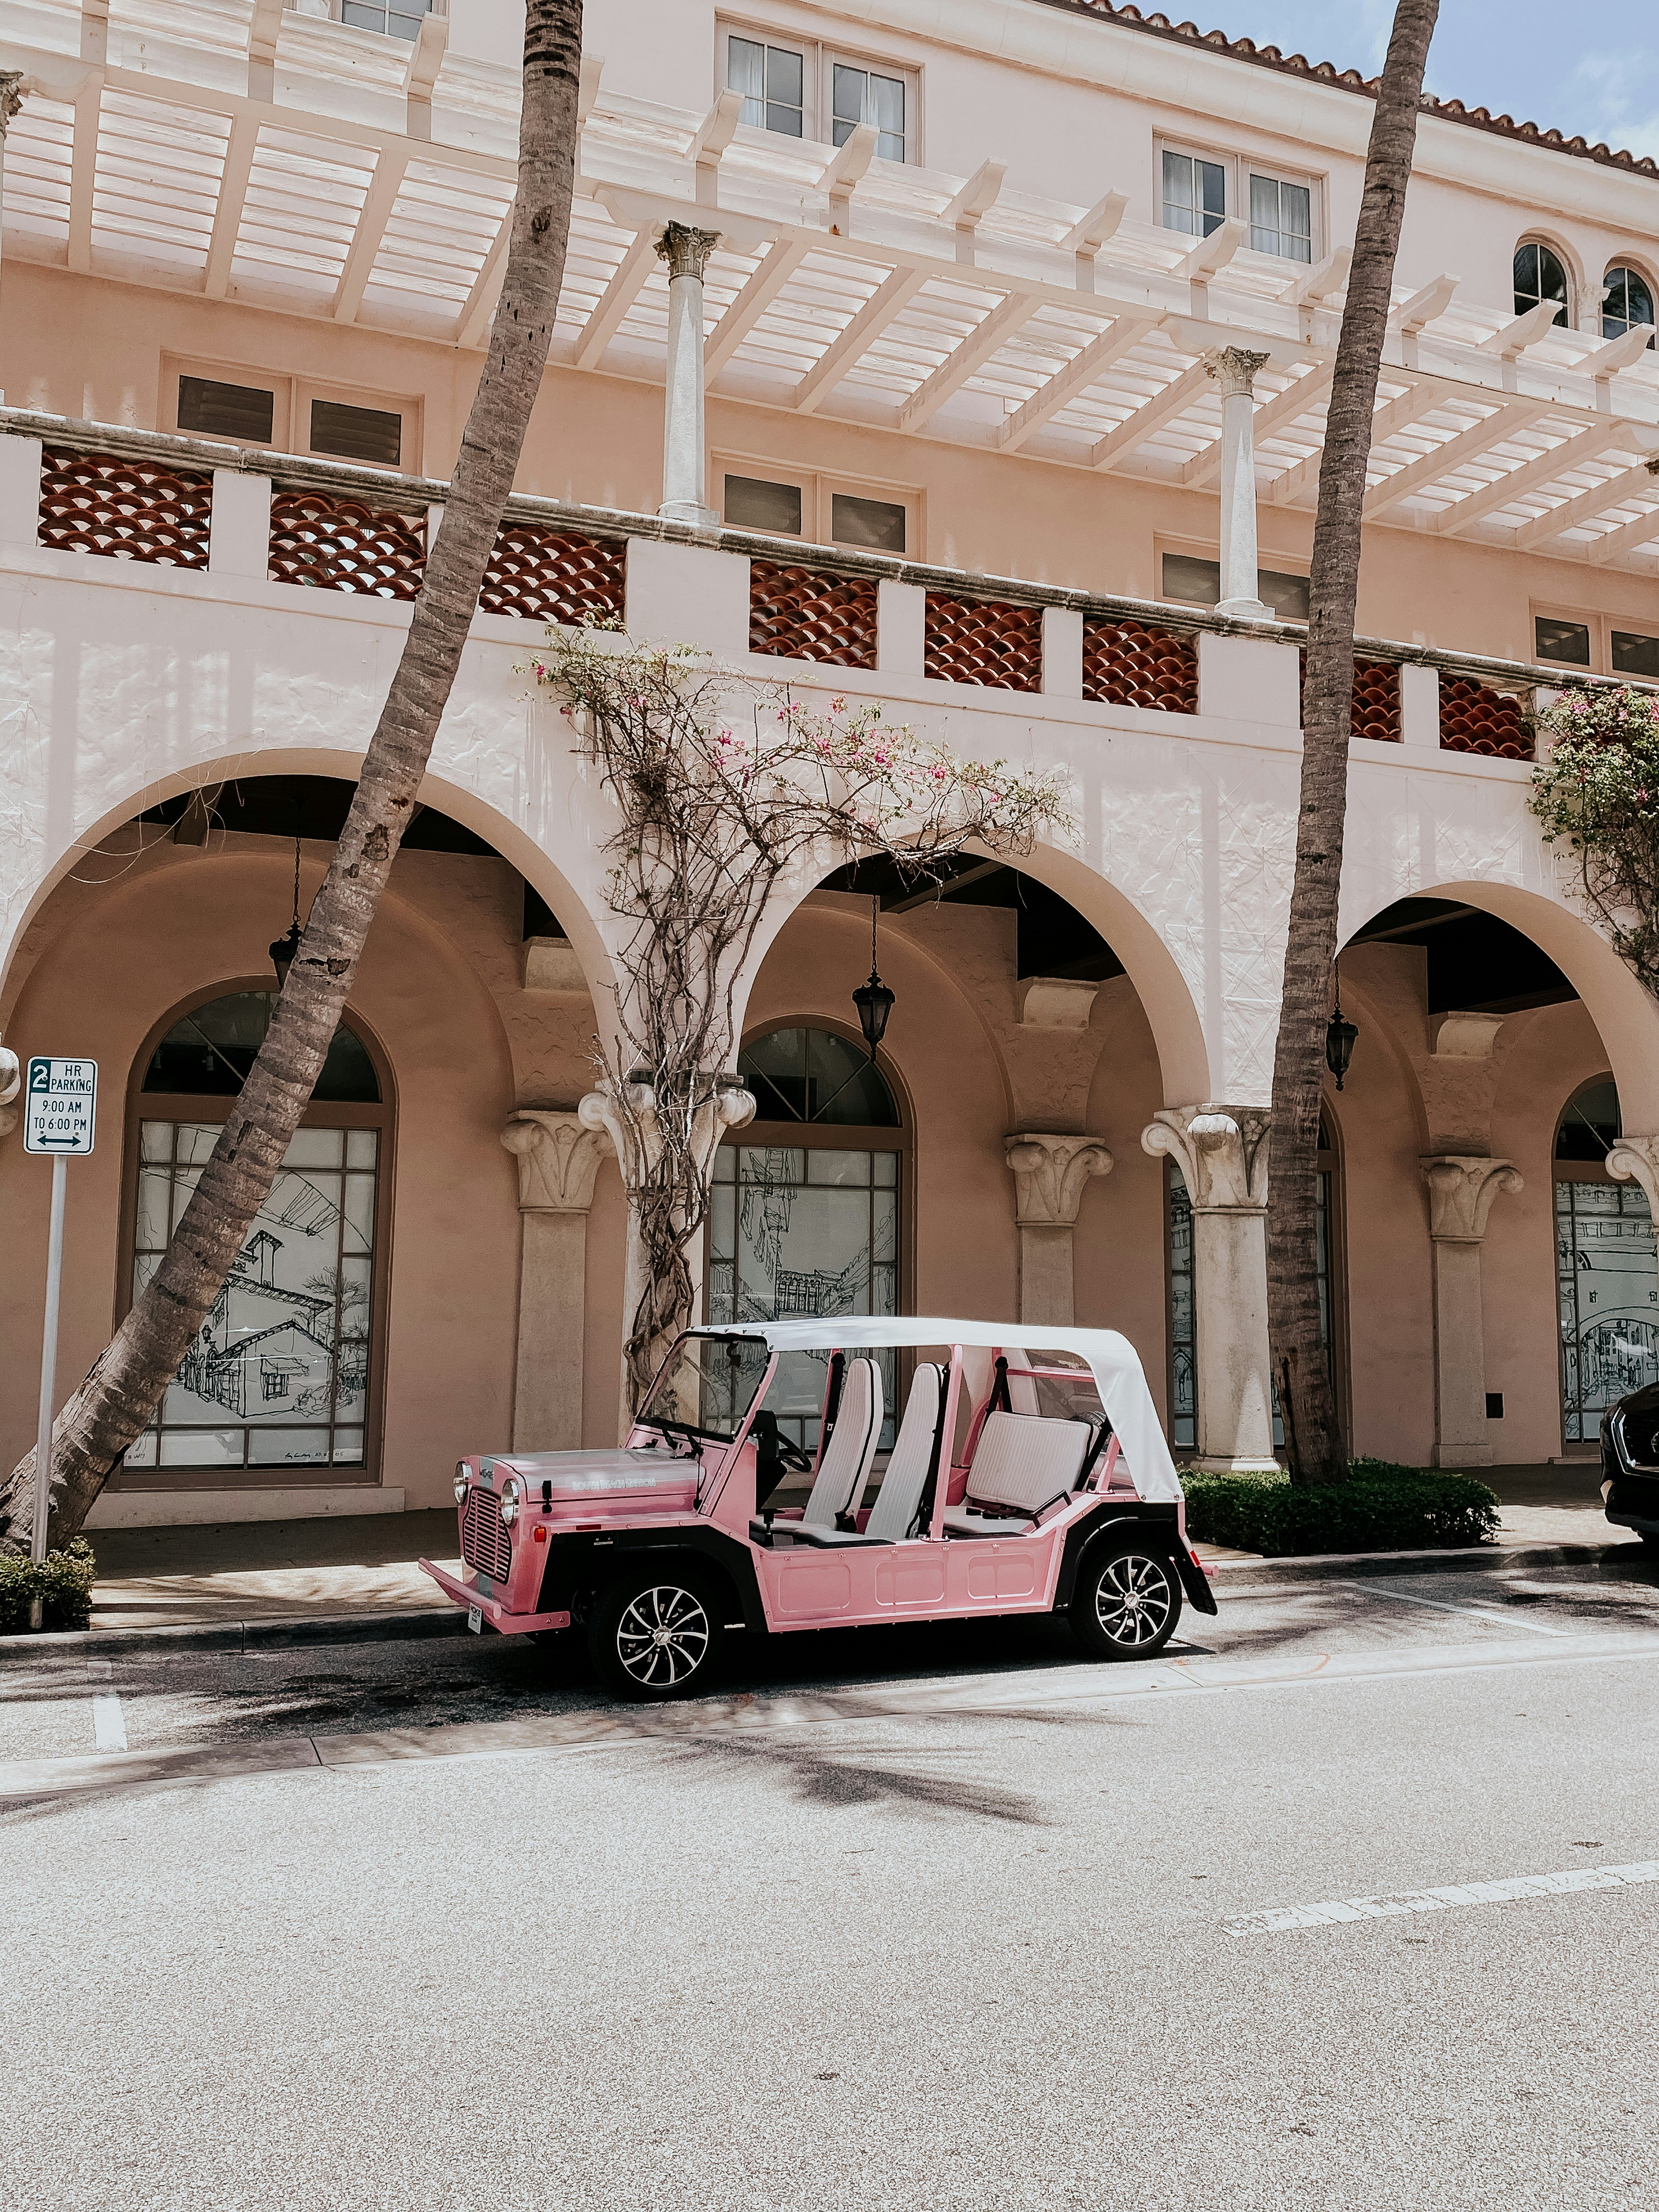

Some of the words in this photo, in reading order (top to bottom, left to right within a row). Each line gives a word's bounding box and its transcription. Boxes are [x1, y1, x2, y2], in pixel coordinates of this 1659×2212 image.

[33, 1065, 48, 1088] 2
[65, 1065, 81, 1076] HR
[51, 1079, 91, 1091] PARKING
[67, 1102, 81, 1113] AM
[34, 1118, 44, 1128] TO
[74, 1119, 86, 1130] PM
